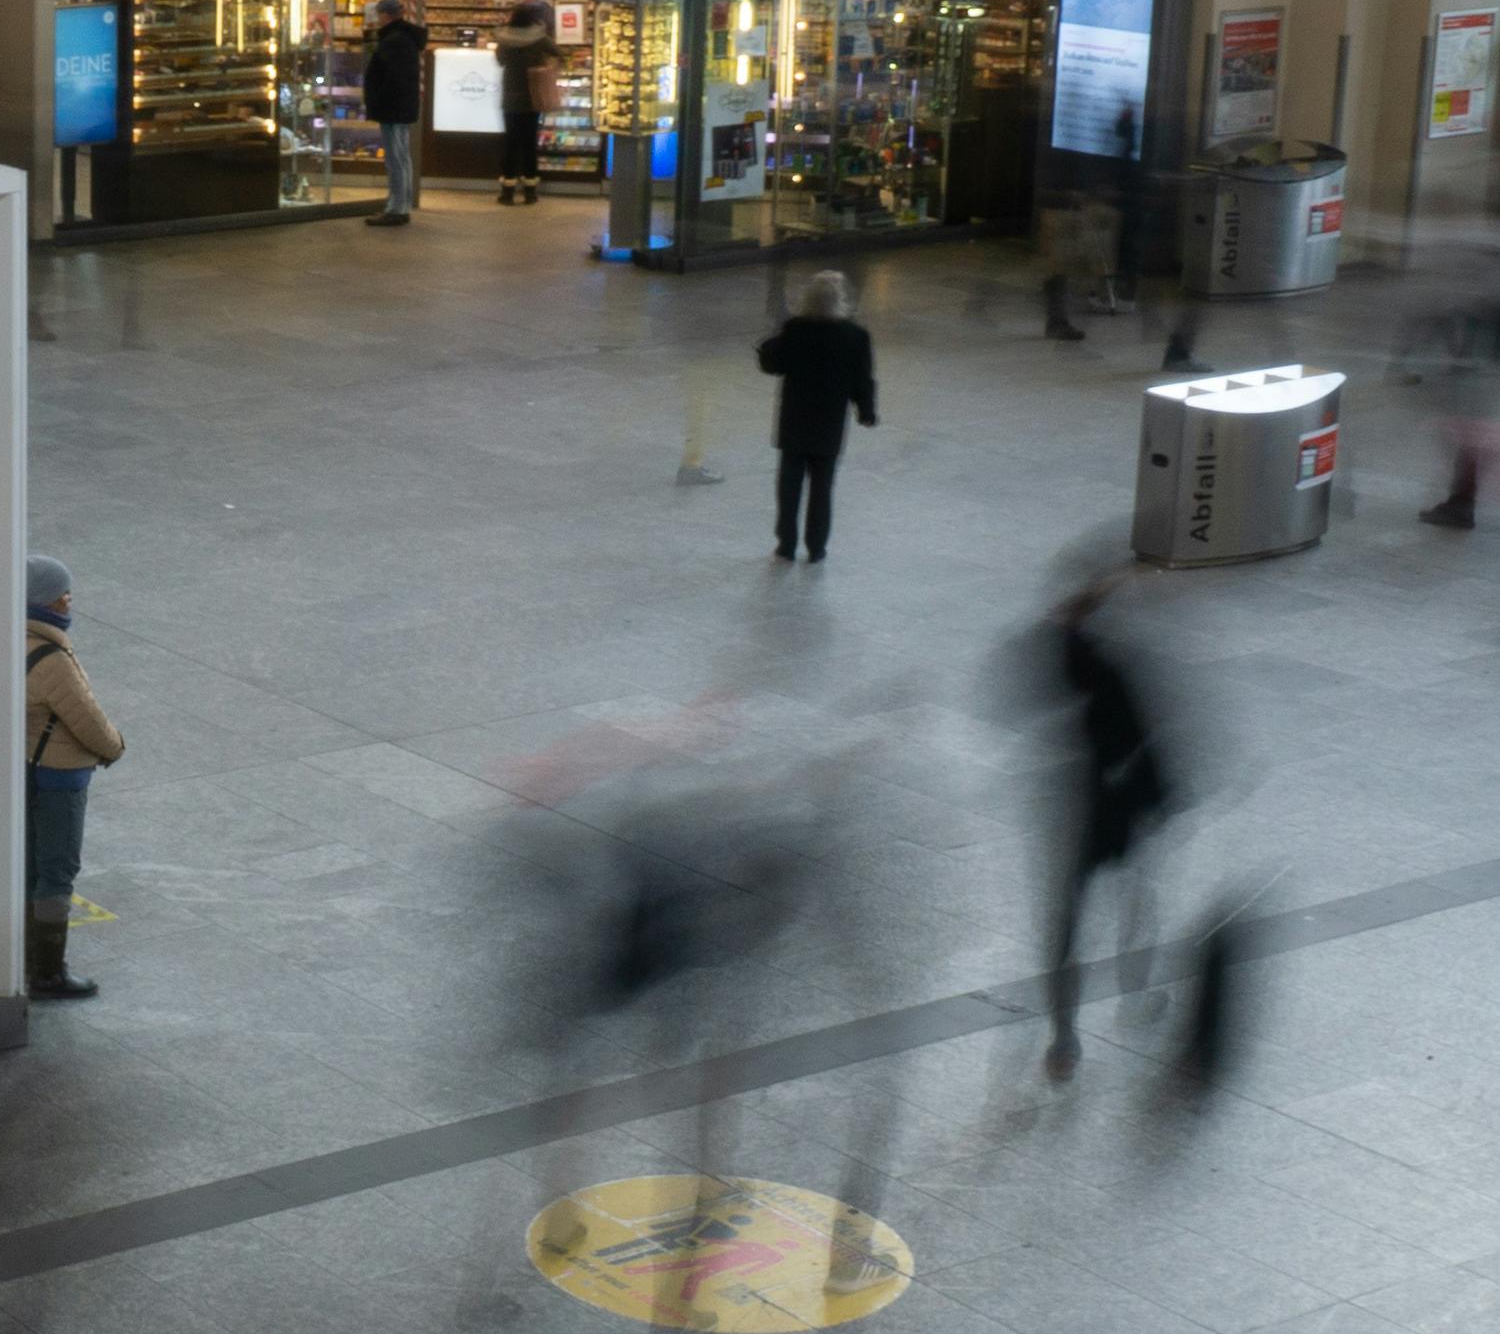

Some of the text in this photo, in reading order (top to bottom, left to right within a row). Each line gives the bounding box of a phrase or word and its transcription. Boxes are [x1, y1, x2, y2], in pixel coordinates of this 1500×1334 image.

[56, 52, 112, 78] DEINE
[1220, 207, 1240, 279] Abfall
[1190, 452, 1217, 544] Abfall
